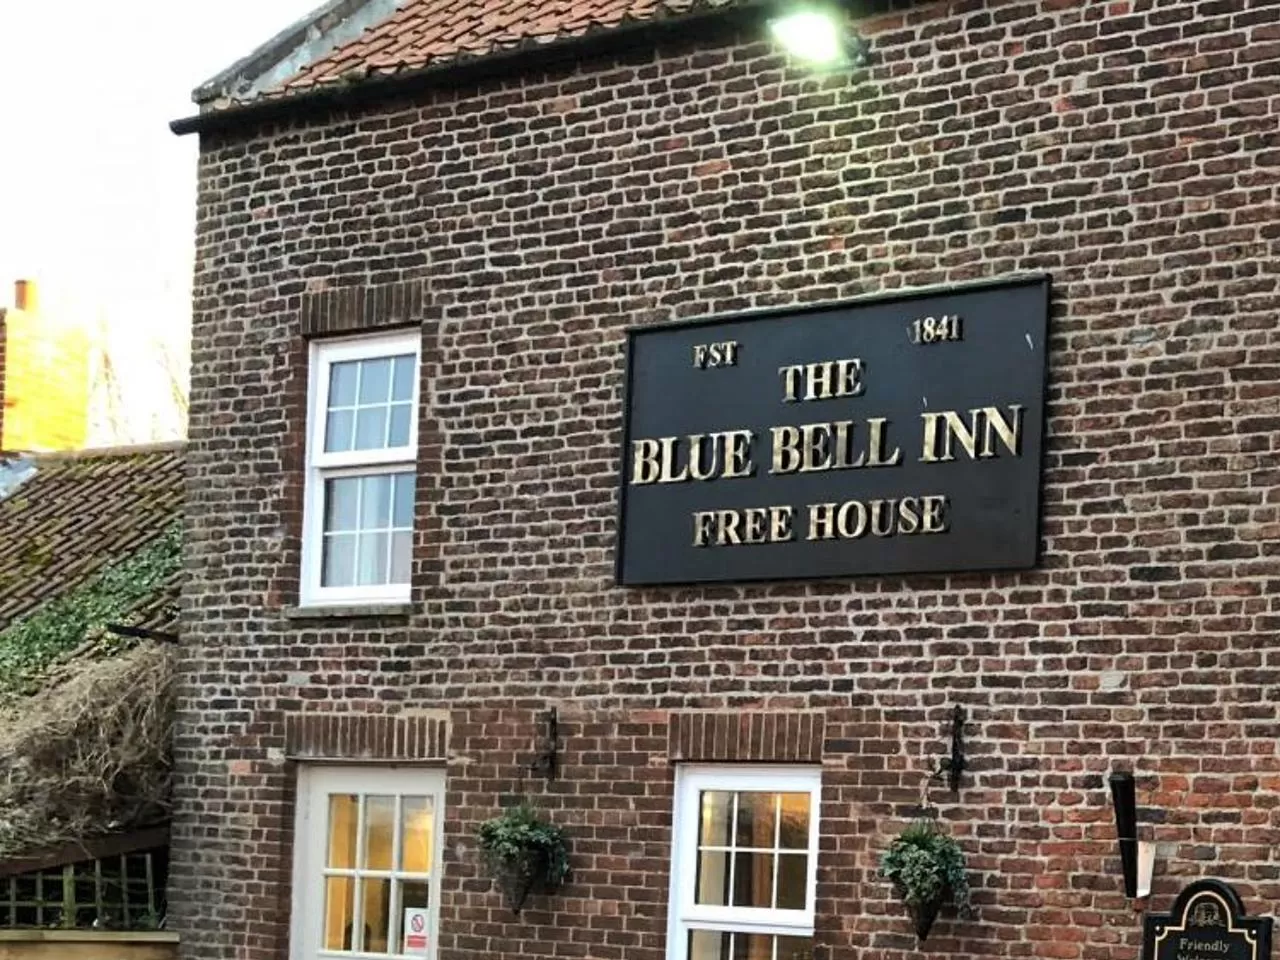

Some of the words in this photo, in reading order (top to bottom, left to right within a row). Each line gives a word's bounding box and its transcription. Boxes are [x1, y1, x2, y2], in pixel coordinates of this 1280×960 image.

[692, 340, 738, 369] EST
[911, 315, 961, 344] 1841
[778, 358, 863, 402] THE
[631, 429, 755, 485] BLUE
[768, 417, 901, 475] BELL
[918, 404, 1025, 463] INN
[692, 505, 794, 548] FREE
[806, 495, 948, 541] HOUSE
[1179, 938, 1230, 953] Friendly
